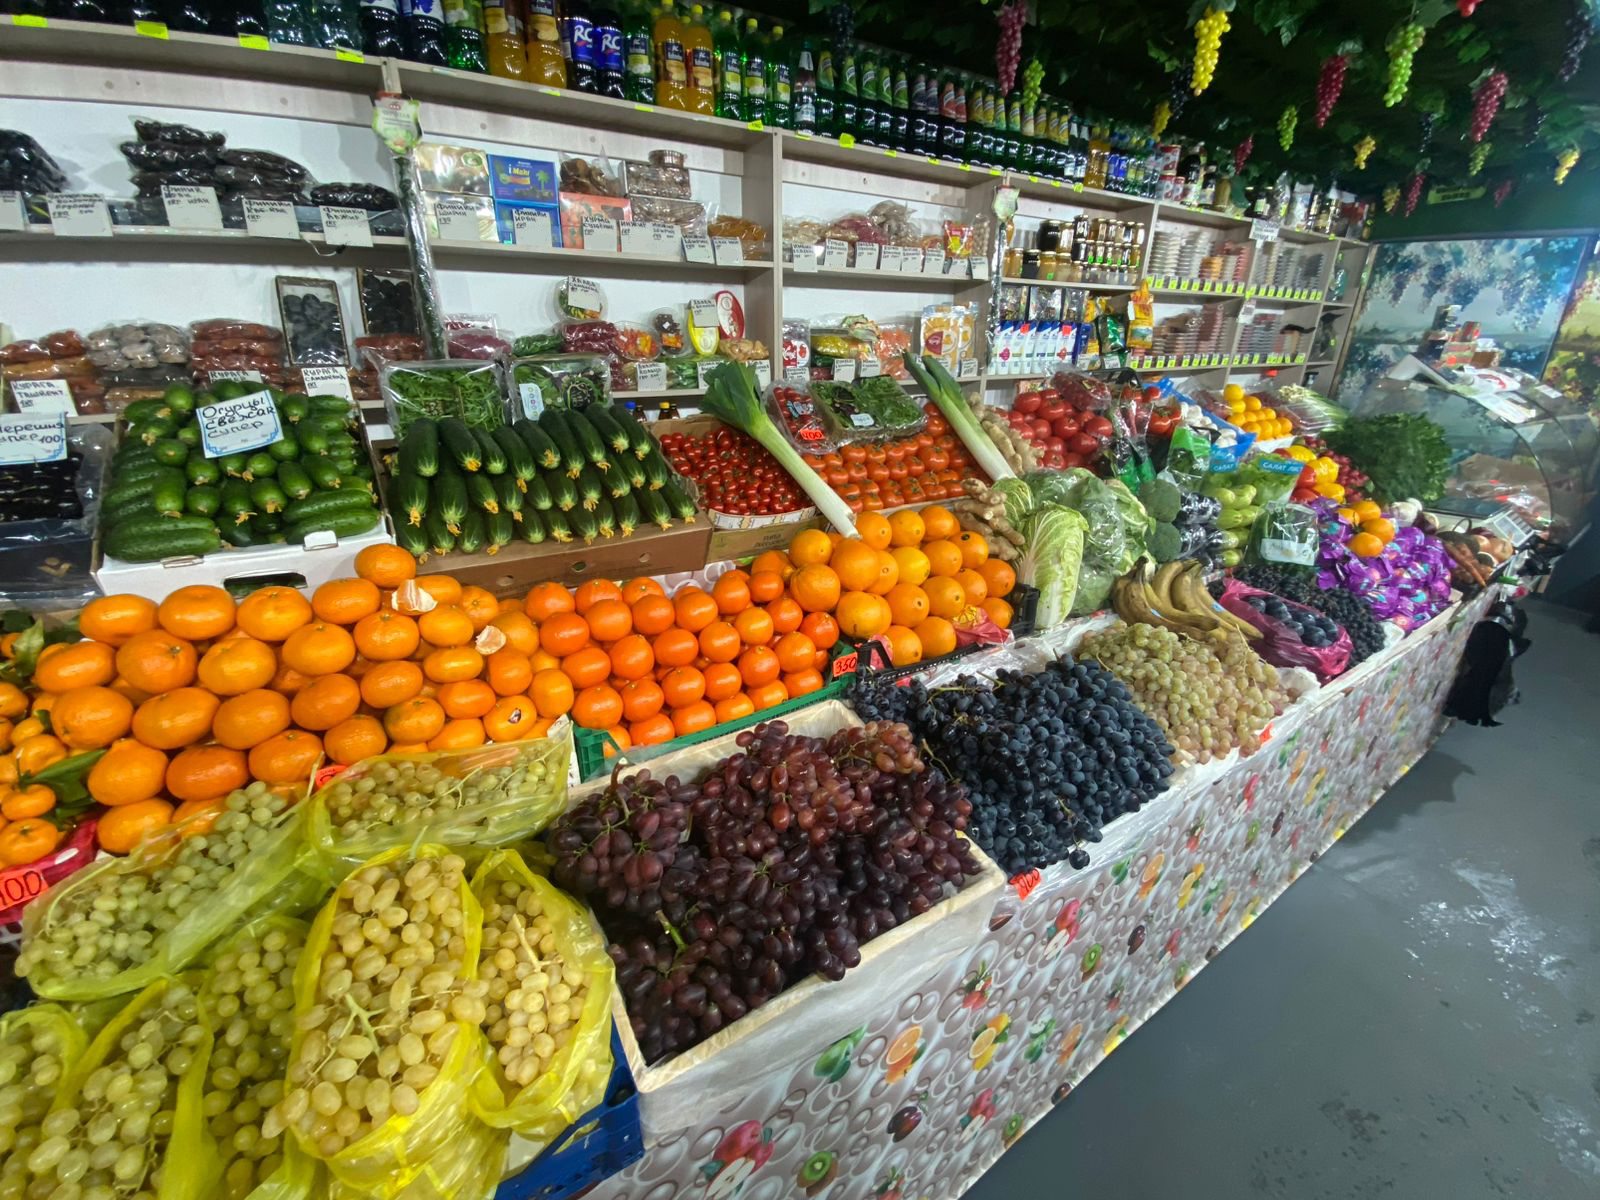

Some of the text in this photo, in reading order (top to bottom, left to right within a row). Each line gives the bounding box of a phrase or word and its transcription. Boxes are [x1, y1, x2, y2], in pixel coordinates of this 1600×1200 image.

[574, 25, 592, 43] RC
[602, 33, 621, 51] RC
[210, 371, 249, 379] КУРАГА
[306, 367, 339, 376] КУРАГА
[12, 381, 55, 390] КУРАГА
[1263, 462, 1285, 472] САЛАТ
[836, 656, 856, 675] 350
